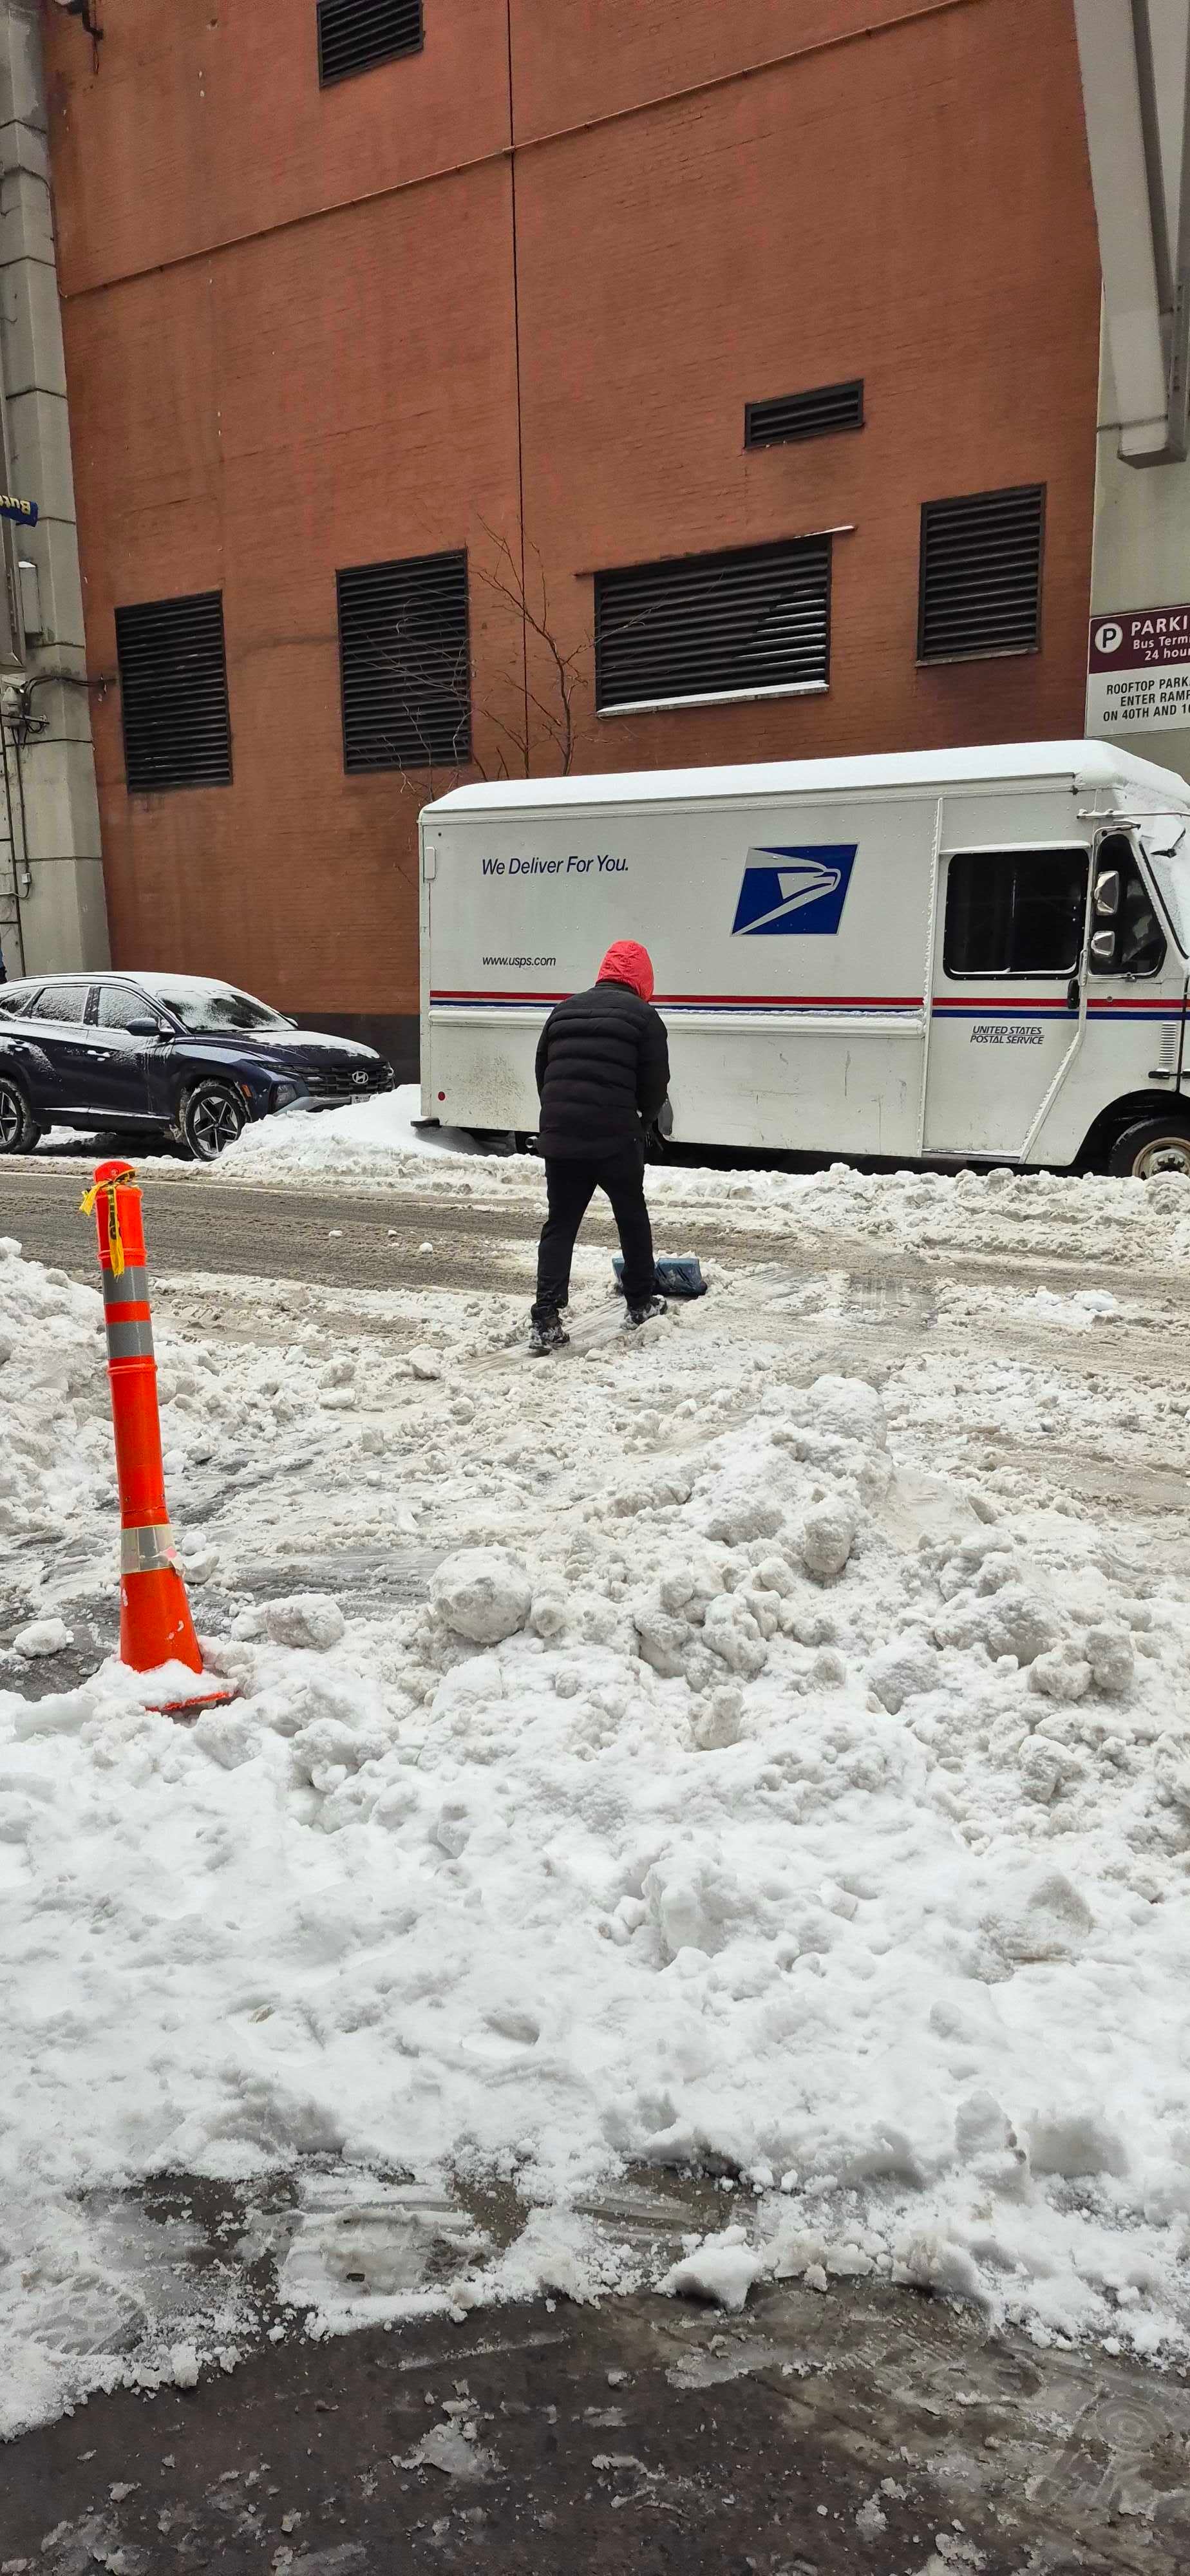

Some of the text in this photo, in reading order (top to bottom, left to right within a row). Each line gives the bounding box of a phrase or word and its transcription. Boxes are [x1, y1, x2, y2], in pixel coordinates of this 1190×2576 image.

[1102, 628, 1117, 649] P
[1133, 639, 1155, 649] Bus
[1144, 649, 1159, 661] 24
[1107, 676, 1190, 695] ROOFTOP PARK
[1120, 694, 1155, 706] ENTER
[1103, 703, 1190, 721] ON 40TH AND 1
[482, 855, 628, 875] We Deliver For You.
[482, 956, 556, 968] www.usps.com
[972, 1026, 1043, 1035] UNITED STATES
[970, 1035, 1044, 1045] POSTAL SERVICE
